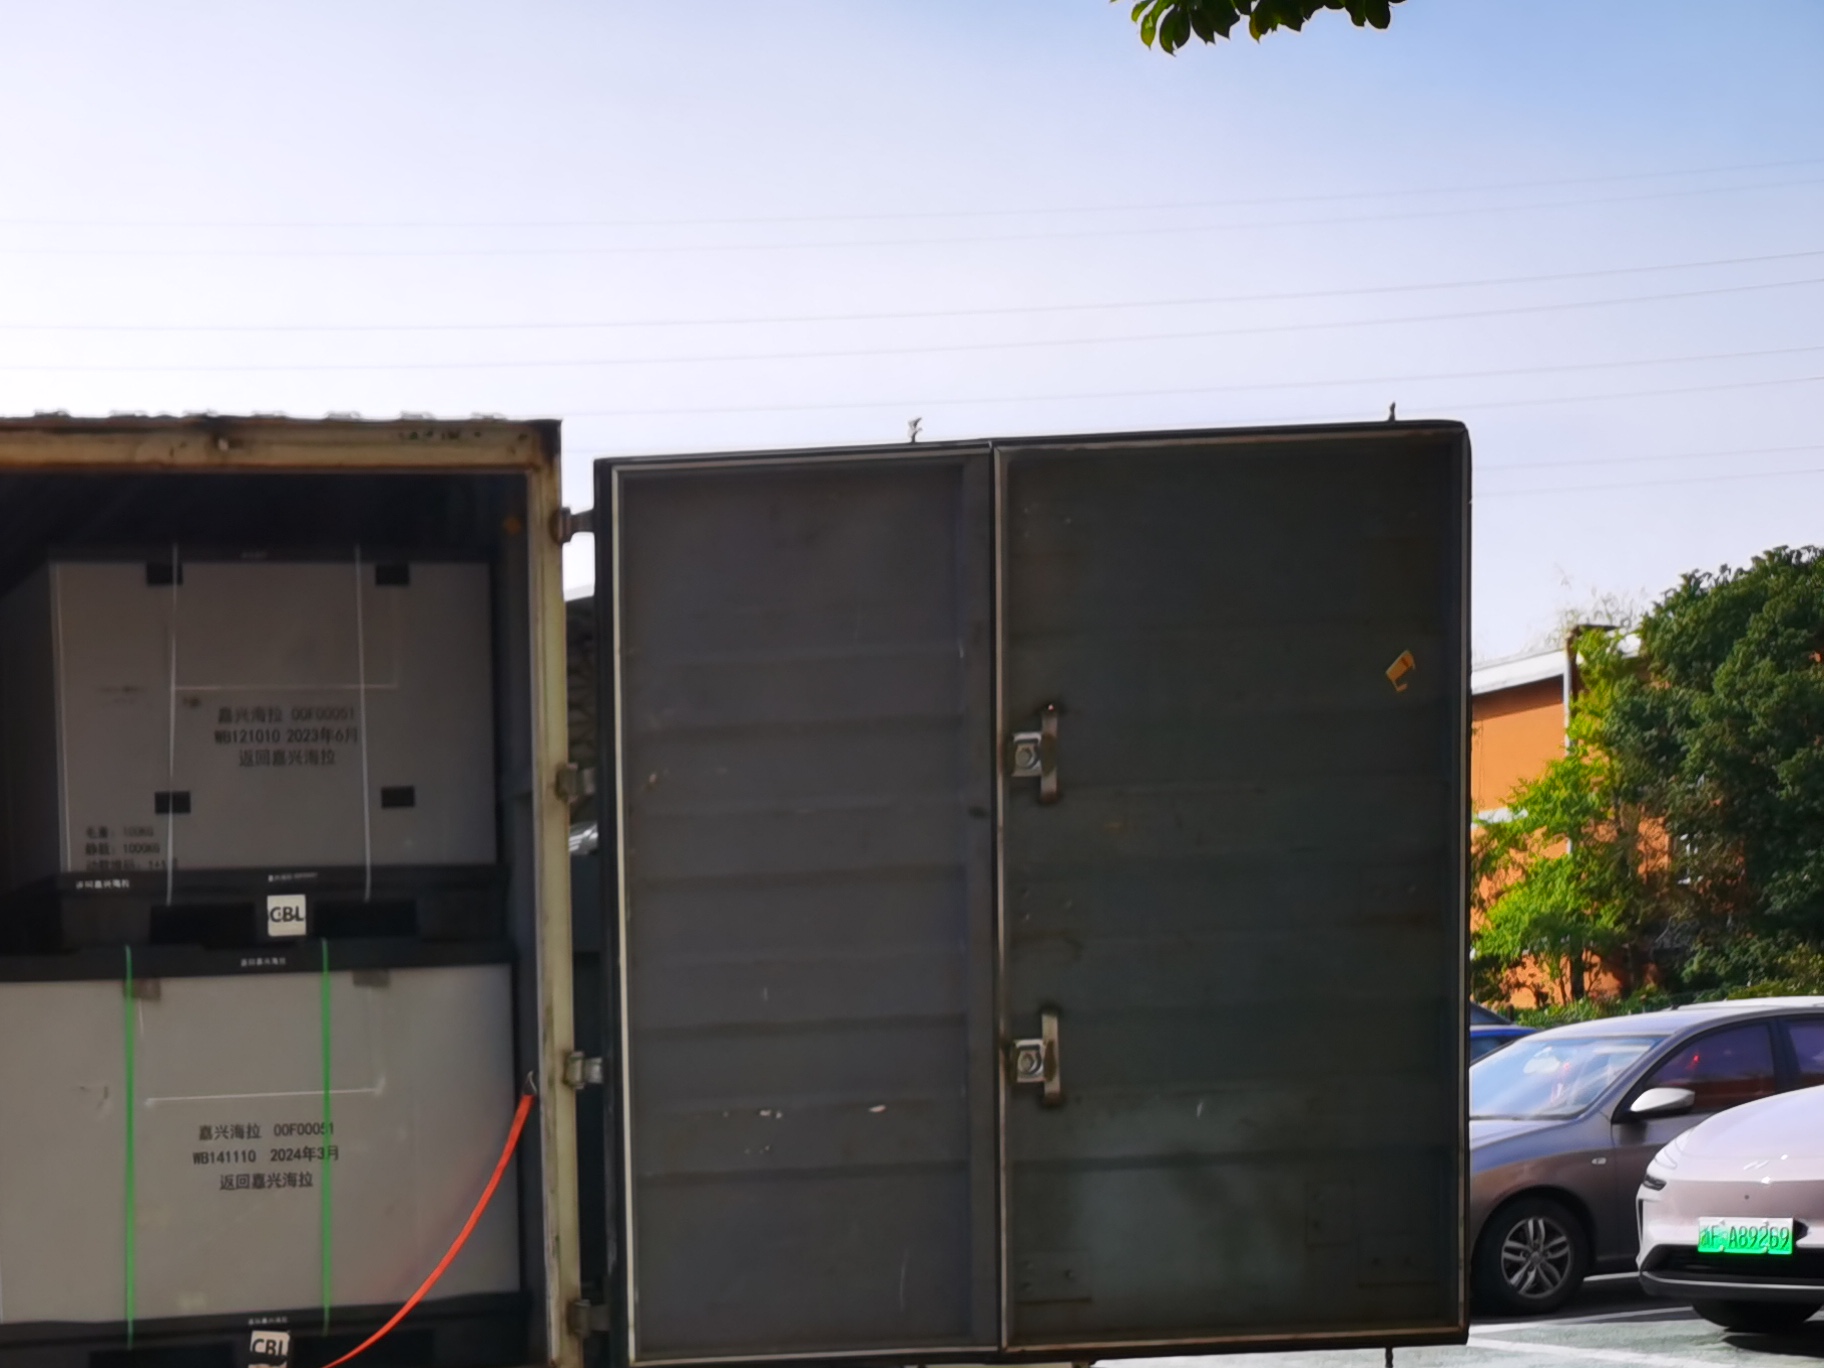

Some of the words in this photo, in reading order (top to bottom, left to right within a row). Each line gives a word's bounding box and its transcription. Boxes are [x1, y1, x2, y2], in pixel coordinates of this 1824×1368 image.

[218, 707, 282, 723] 嘉兴海拉
[239, 748, 335, 766] 返回嘉兴海拉
[270, 906, 304, 922] CBL
[199, 1123, 261, 1140] 嘉兴海拉
[192, 1150, 256, 1165] WB141110
[270, 1145, 339, 1163] 2024年3月
[220, 1171, 313, 1190] 返回嘉兴海拉
